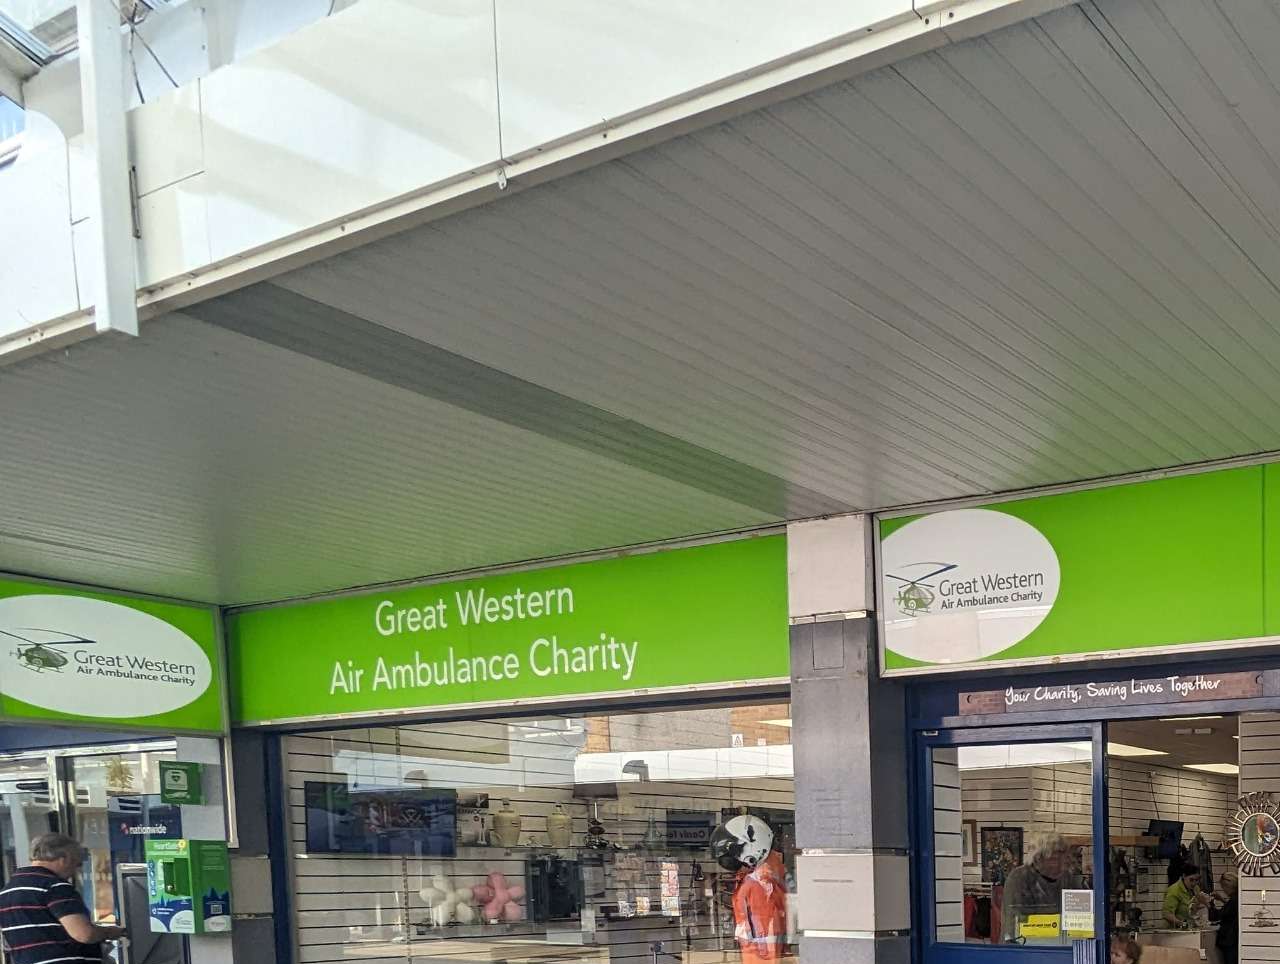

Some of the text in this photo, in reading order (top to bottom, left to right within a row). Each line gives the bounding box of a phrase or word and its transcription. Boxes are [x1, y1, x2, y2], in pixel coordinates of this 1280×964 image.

[940, 572, 1044, 597] Great Western
[375, 585, 574, 635] Great Western
[940, 590, 1043, 609] Air Ambulance Charity
[74, 650, 196, 676] Great Western
[330, 633, 638, 695] Air Ambulance Charity
[76, 665, 196, 687] Air Ambulance Charity
[1004, 675, 1221, 705] Your Charity, Saving Lives Together
[129, 824, 167, 834] nationwide
